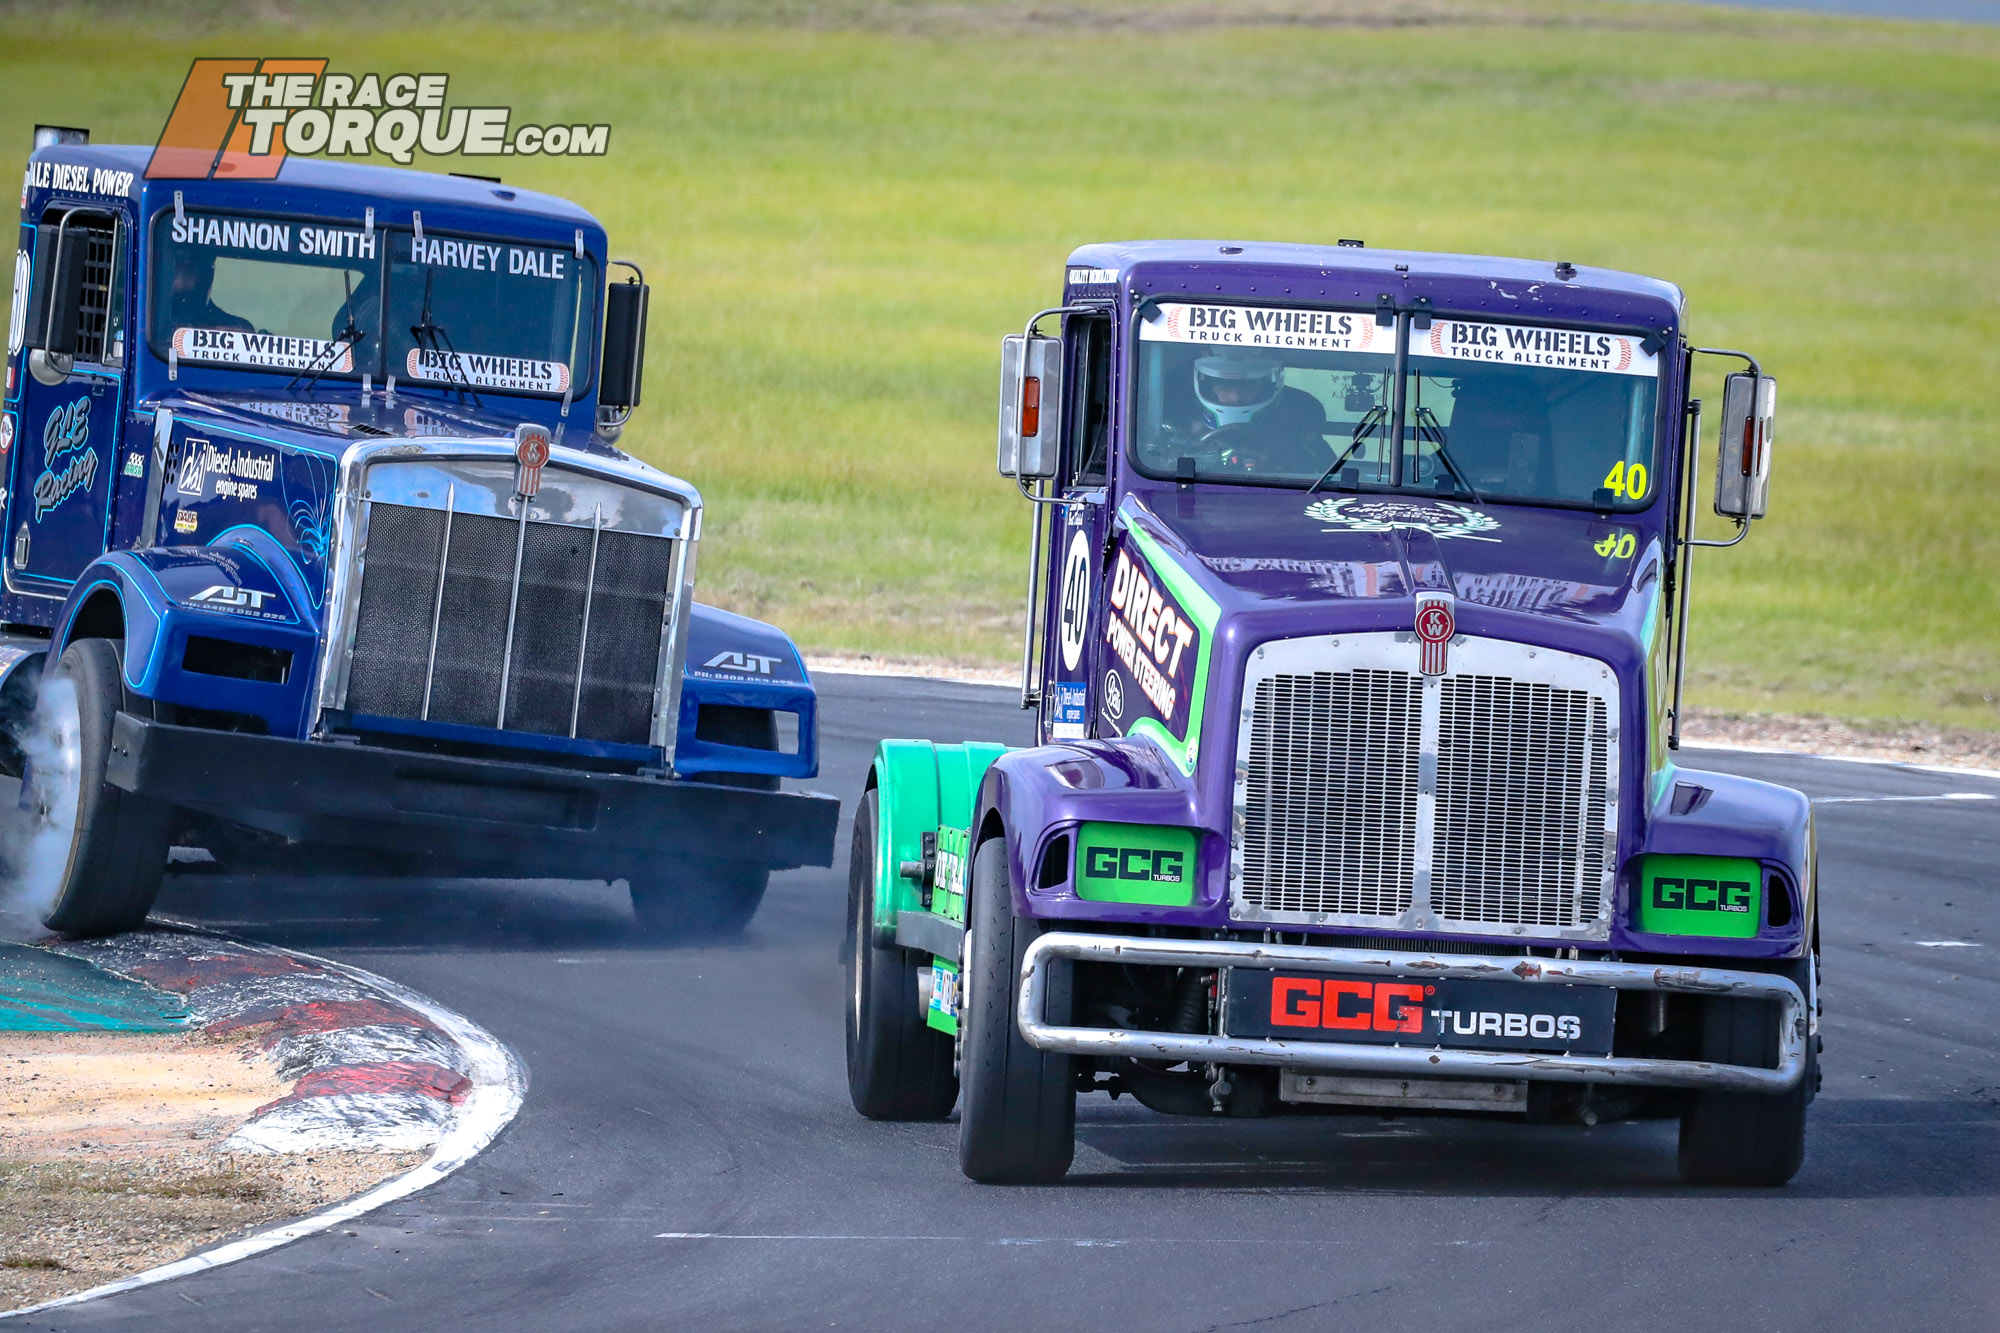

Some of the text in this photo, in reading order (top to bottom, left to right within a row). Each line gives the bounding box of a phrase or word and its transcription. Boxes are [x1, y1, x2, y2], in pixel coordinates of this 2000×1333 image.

[52, 163, 90, 193] DIESEL
[92, 168, 134, 197] POWER
[171, 217, 375, 259] SHANNON SMITH
[411, 237, 565, 279] HARVEY DALE
[1189, 307, 1352, 336] BIG WHEELS
[192, 329, 336, 360] BIG WHEELS
[1189, 330, 1351, 349] TRUCK ALIGNMENT
[1451, 323, 1611, 356] BIG WHEELS
[192, 350, 335, 371] TRUCK ALIGNMENT
[424, 350, 553, 380] BIG WHEELS
[1451, 346, 1610, 370] TRUCK ALIGNMENT
[425, 370, 552, 391] TRUCK ALIGNMENT
[206, 445, 275, 482] Diesel & Industrial
[1603, 460, 1647, 500] 40
[33, 447, 98, 523] Racing
[215, 477, 258, 502] engine spares
[1063, 554, 1087, 645] 40
[1110, 546, 1194, 679] DIRECT
[1106, 611, 1137, 674] POWER
[1134, 647, 1176, 720] STEERING
[1085, 846, 1184, 883] GCG
[1153, 874, 1180, 882] TURBOS
[1652, 877, 1751, 913] GCG
[1720, 904, 1748, 912] TURBOS
[1270, 976, 1581, 1041] GCG TURBOS
